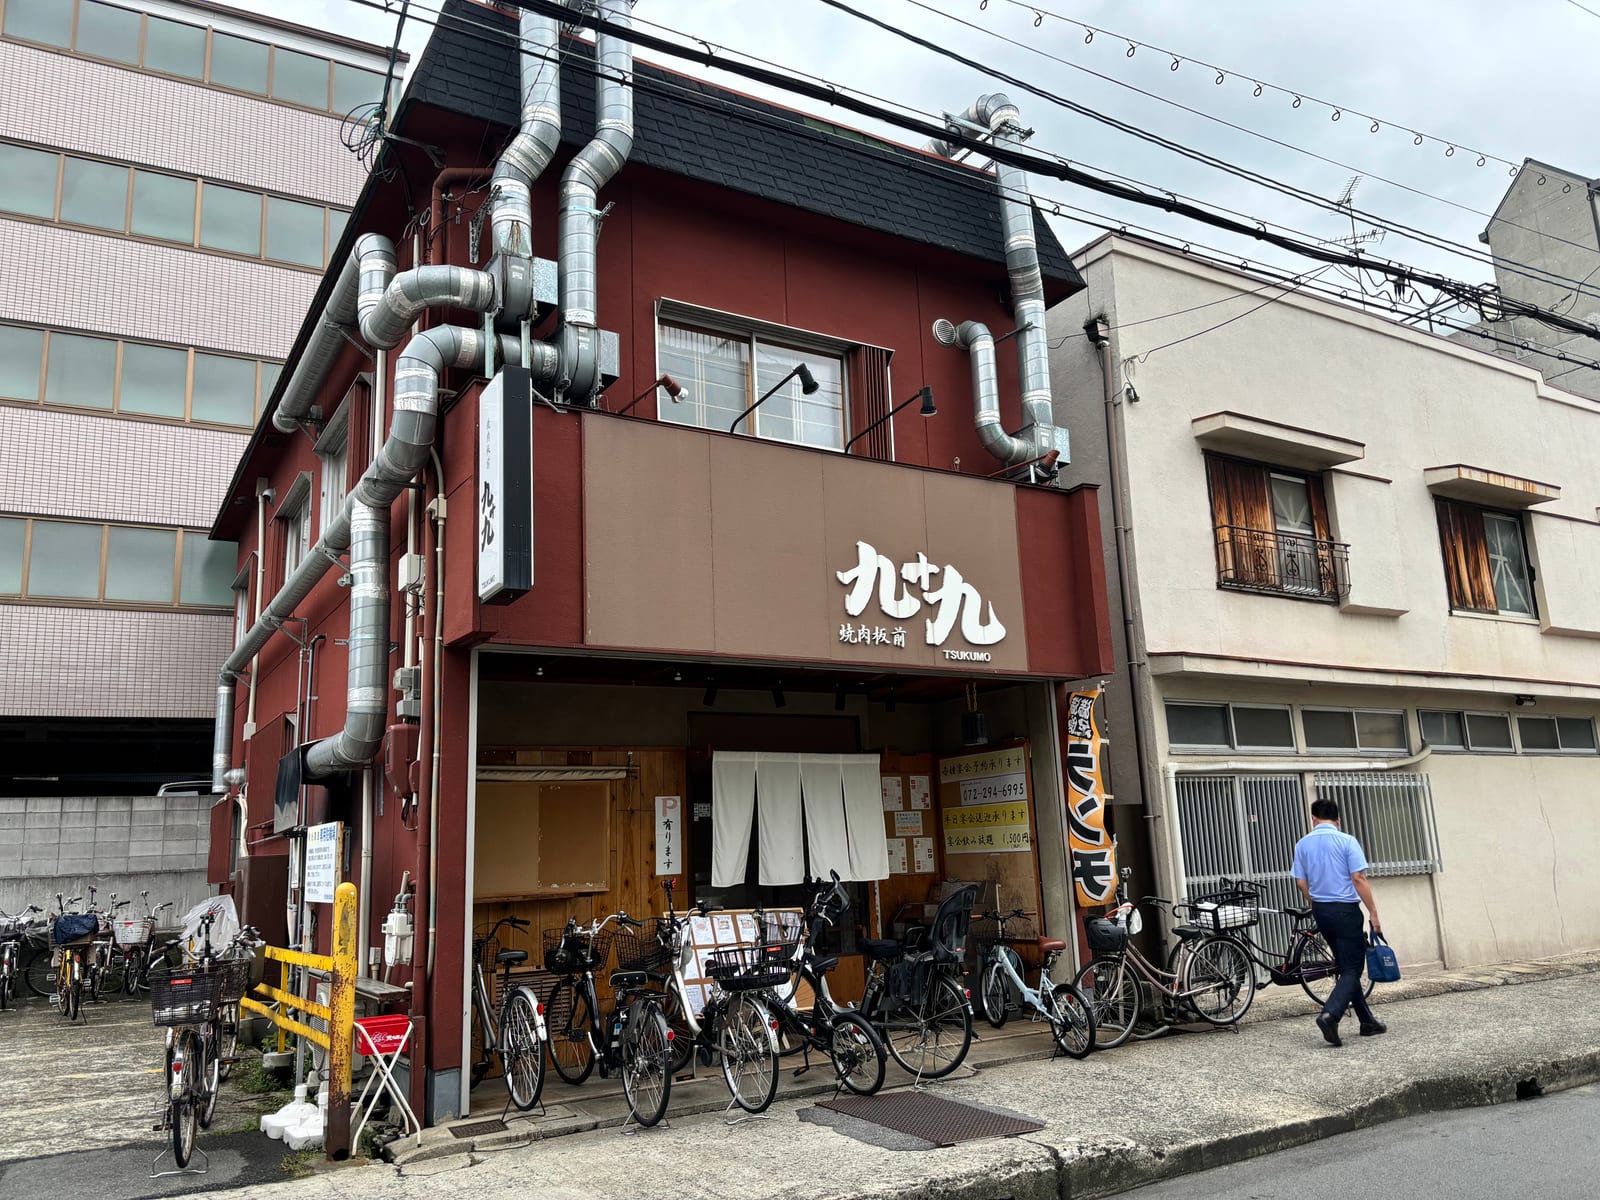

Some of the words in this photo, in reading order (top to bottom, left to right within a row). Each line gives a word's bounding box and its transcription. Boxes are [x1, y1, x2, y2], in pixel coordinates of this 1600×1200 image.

[481, 481, 496, 552] 九十九
[836, 540, 1006, 646] 九十九
[839, 623, 907, 648] 焼肉板前
[943, 649, 991, 662] TSUKUMO
[963, 783, 1024, 801] 072-294-6995
[661, 798, 678, 817] P
